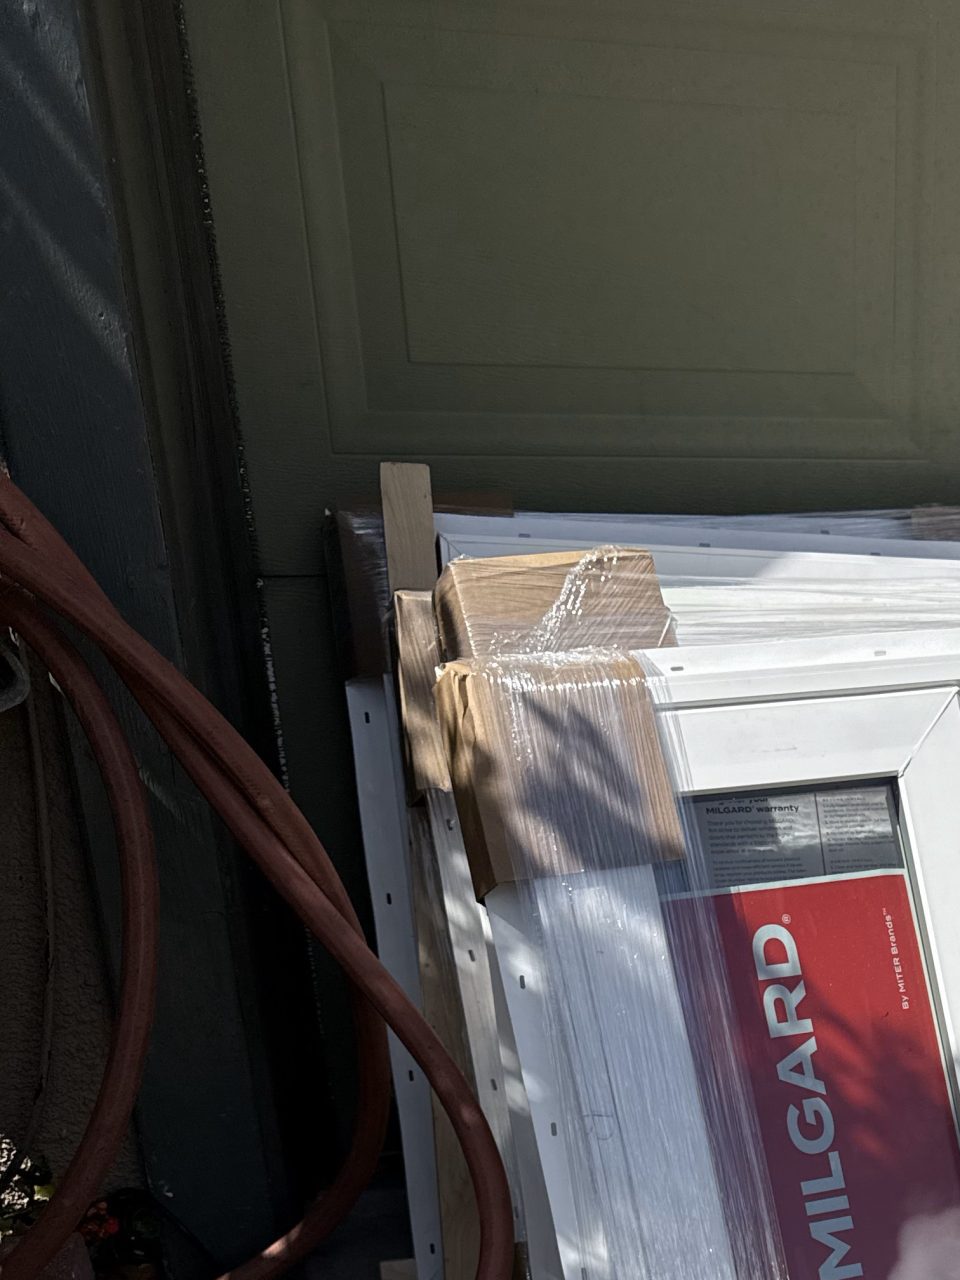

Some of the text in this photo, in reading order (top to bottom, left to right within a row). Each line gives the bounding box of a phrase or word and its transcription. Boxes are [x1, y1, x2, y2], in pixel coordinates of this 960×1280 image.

[755, 804, 799, 813] warranty
[892, 957, 906, 993] MITER
[901, 995, 910, 1010] By
